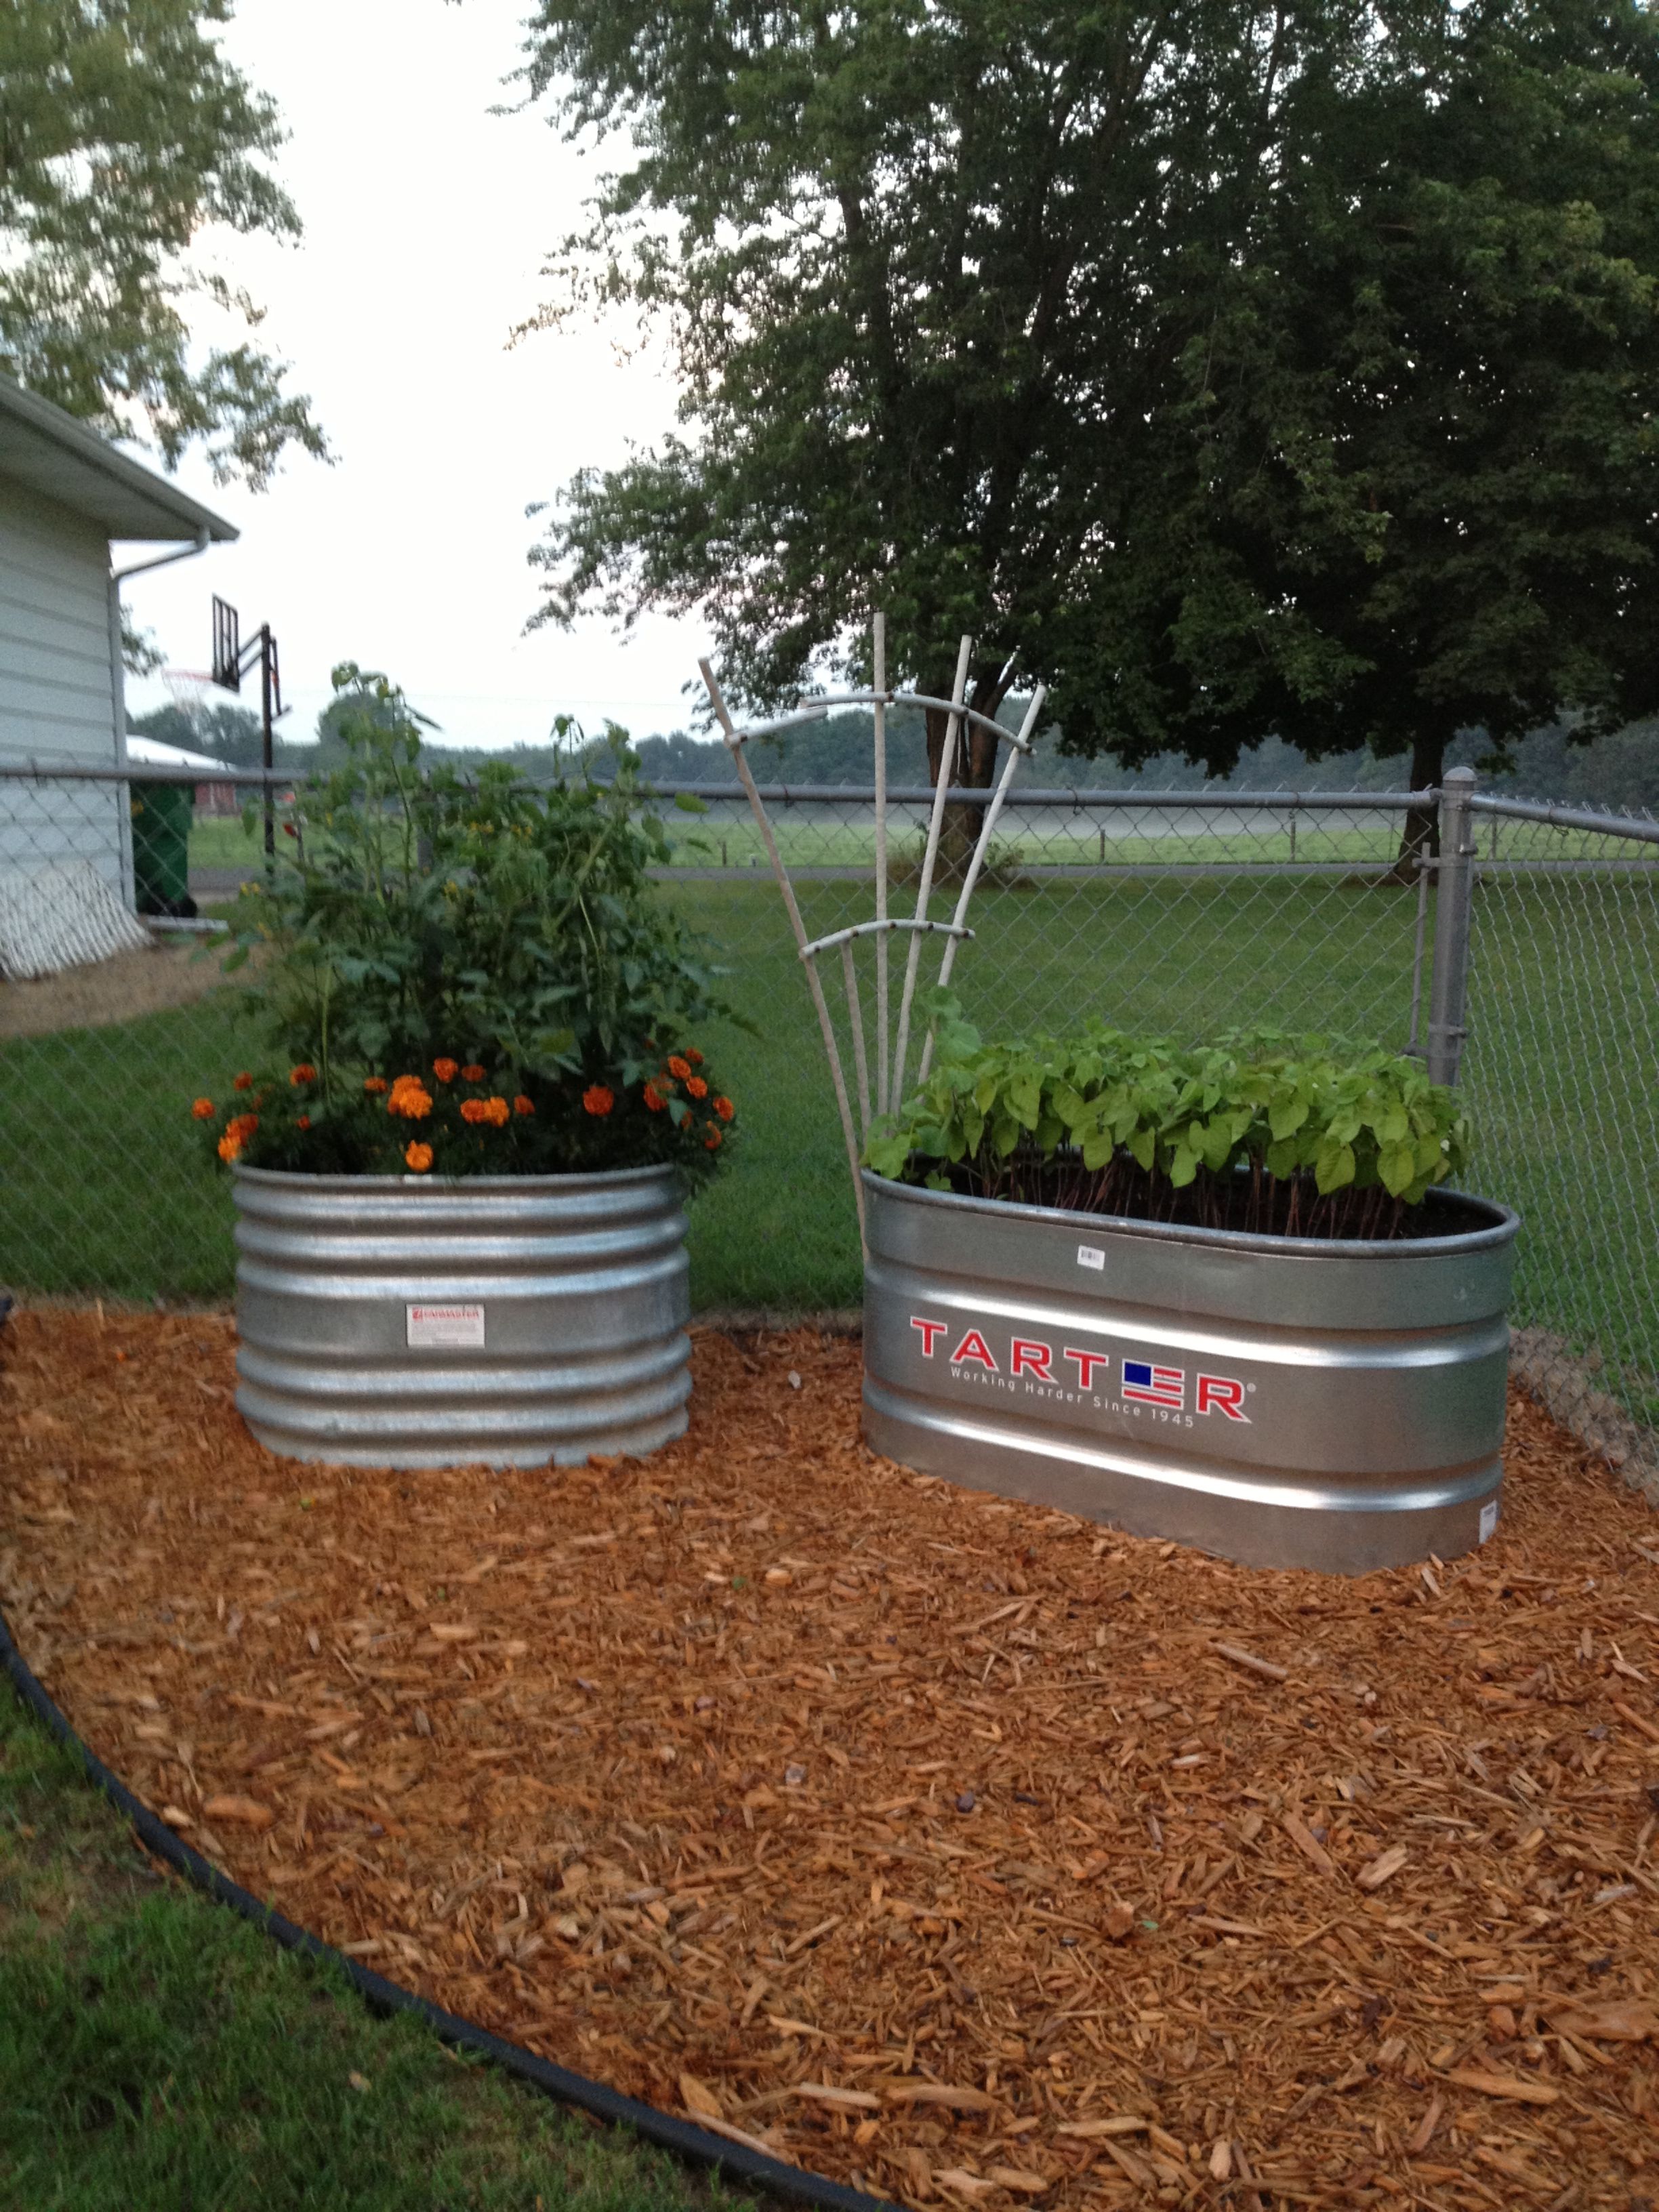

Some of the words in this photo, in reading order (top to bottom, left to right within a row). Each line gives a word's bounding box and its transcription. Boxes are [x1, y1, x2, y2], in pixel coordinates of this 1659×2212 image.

[950, 1366, 1015, 1391] Working
[1025, 1381, 1083, 1404] Harder
[1093, 1395, 1141, 1416] Since
[1151, 1408, 1194, 1428] 1945
